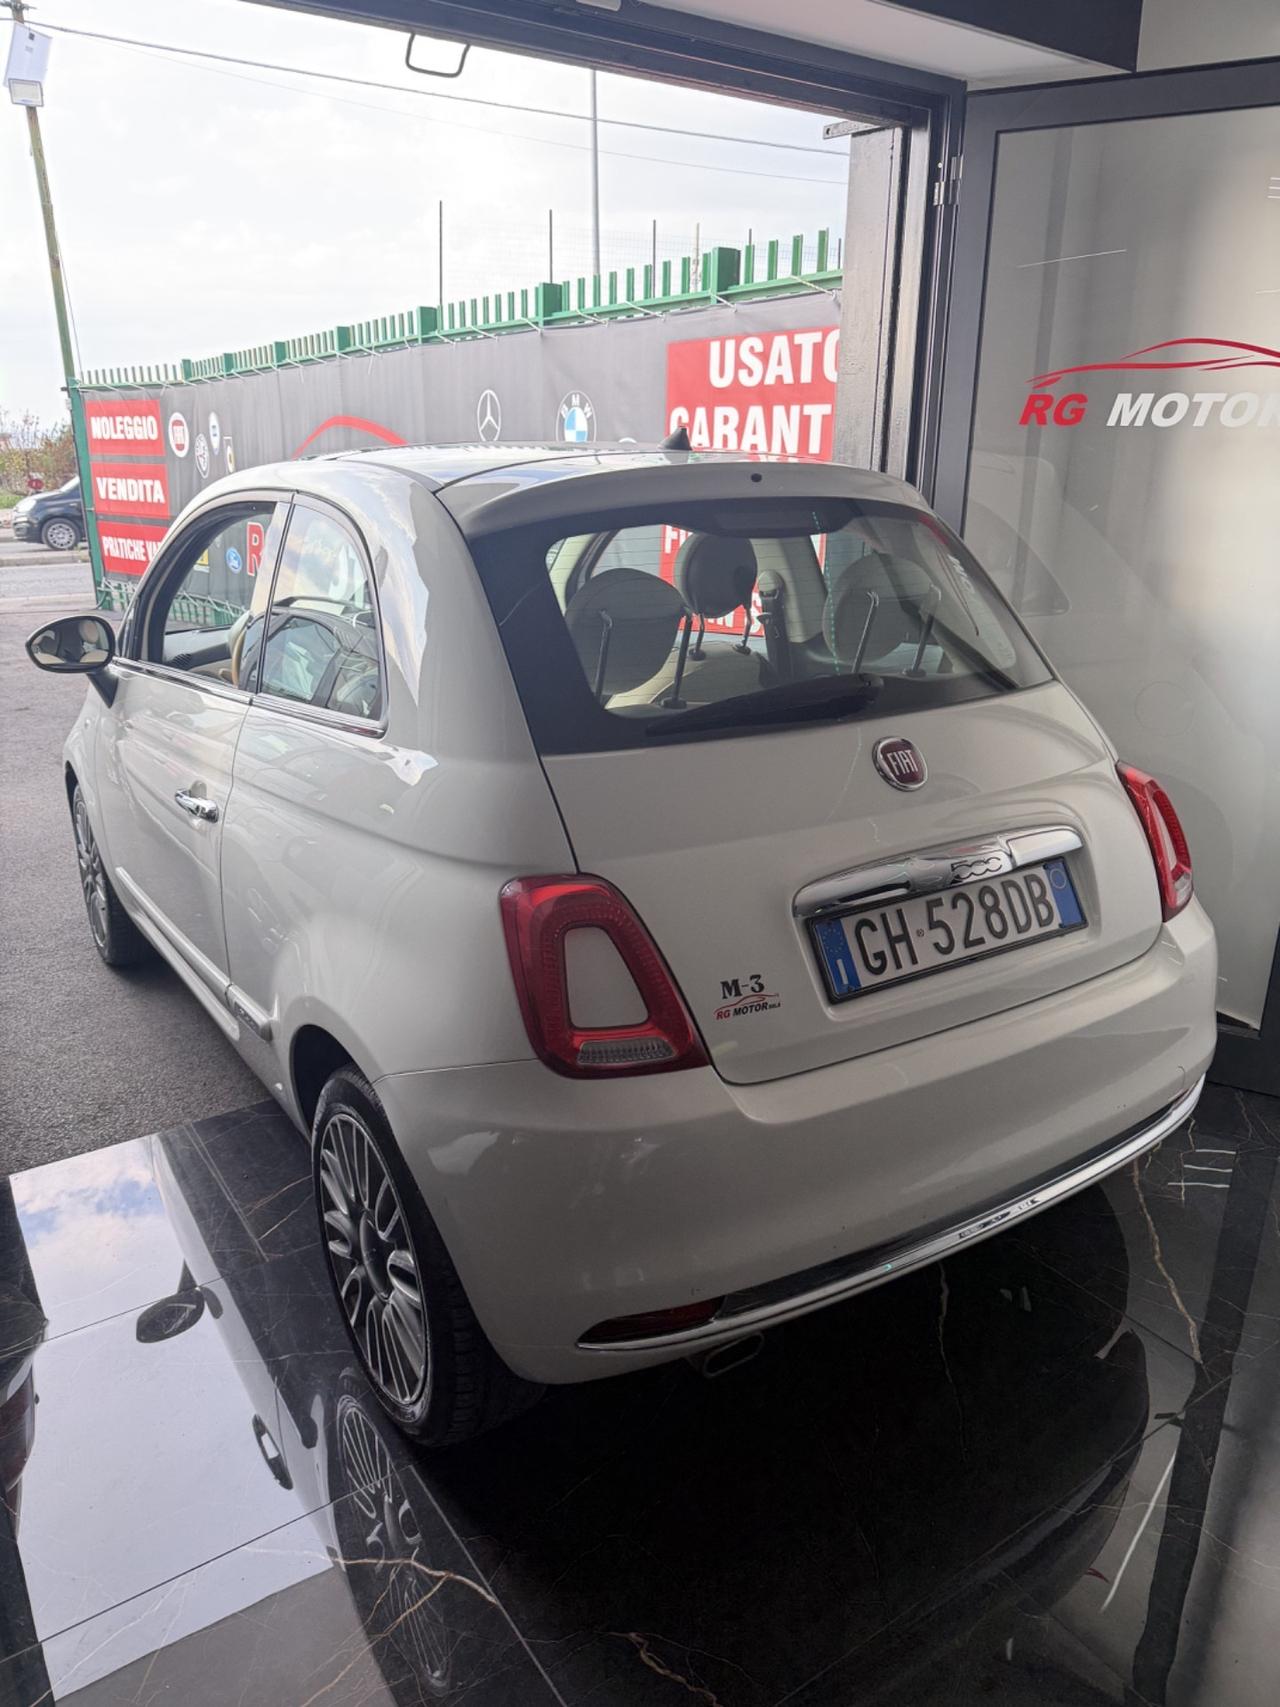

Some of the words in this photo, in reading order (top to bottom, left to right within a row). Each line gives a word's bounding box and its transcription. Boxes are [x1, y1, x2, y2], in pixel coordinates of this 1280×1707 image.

[709, 328, 841, 388] USATO
[1018, 393, 1088, 427] RG
[90, 415, 159, 441] NOLEGGIO
[95, 476, 166, 504] VENDITA
[101, 535, 146, 562] PRATICHE
[886, 749, 919, 776] FIAT
[950, 856, 1003, 882] 500
[854, 908, 919, 976] GH
[926, 873, 1055, 955] 528DB
[720, 974, 765, 1000] M-3
[716, 1009, 731, 1021] RG
[733, 1002, 768, 1016] MOTOR
